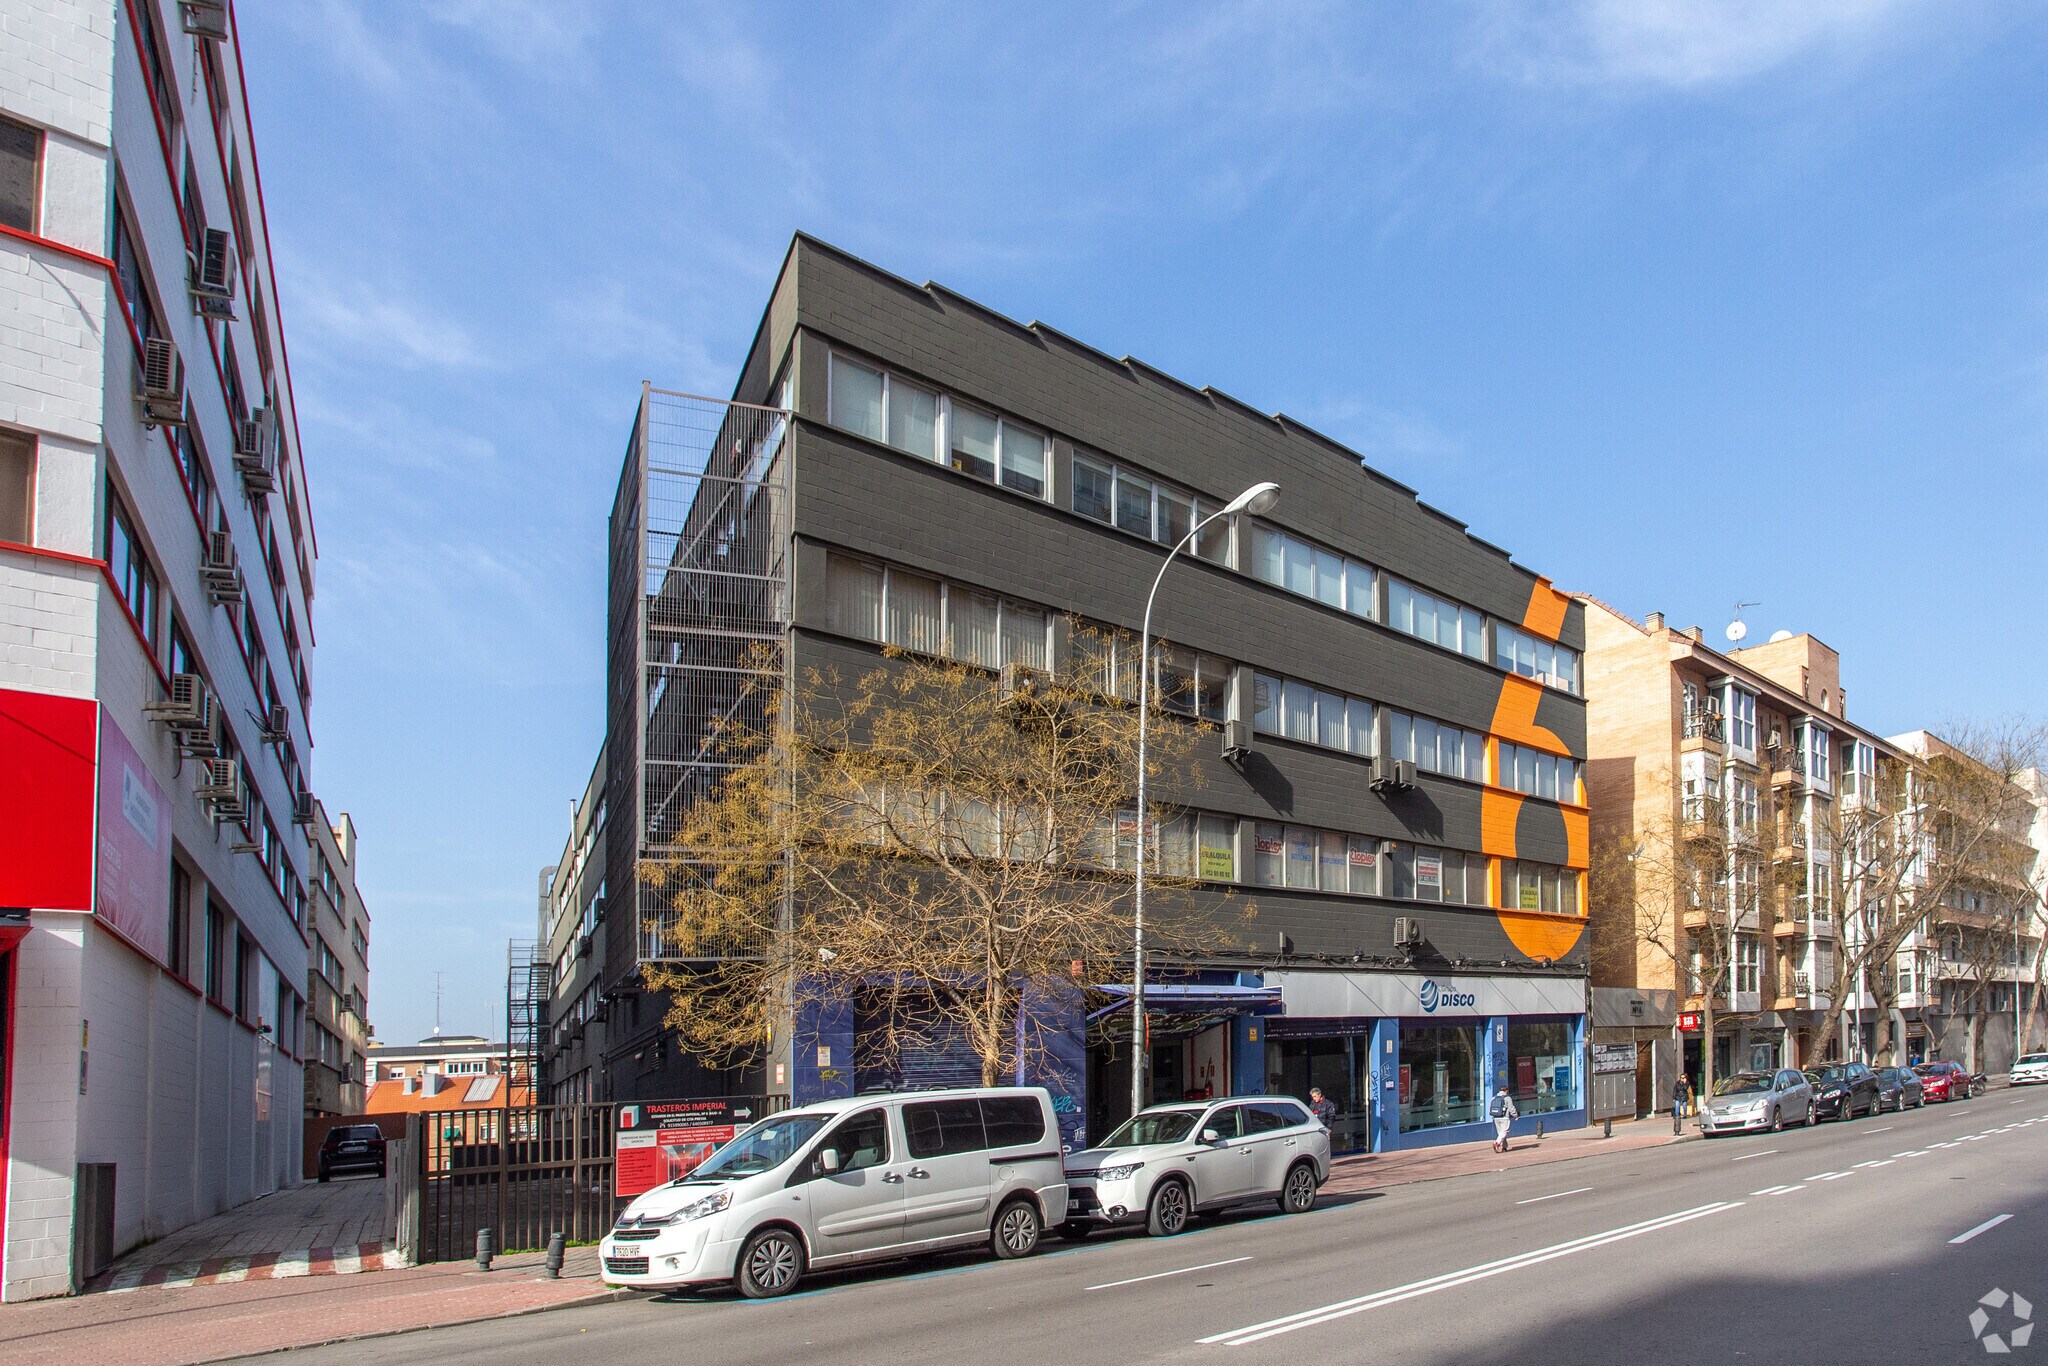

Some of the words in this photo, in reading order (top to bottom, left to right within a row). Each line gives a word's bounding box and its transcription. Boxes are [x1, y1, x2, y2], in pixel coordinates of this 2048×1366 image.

[1441, 993, 1475, 1007] DISCO
[646, 1103, 691, 1113] TRASTEROS
[692, 1102, 728, 1111] IMPERIAL
